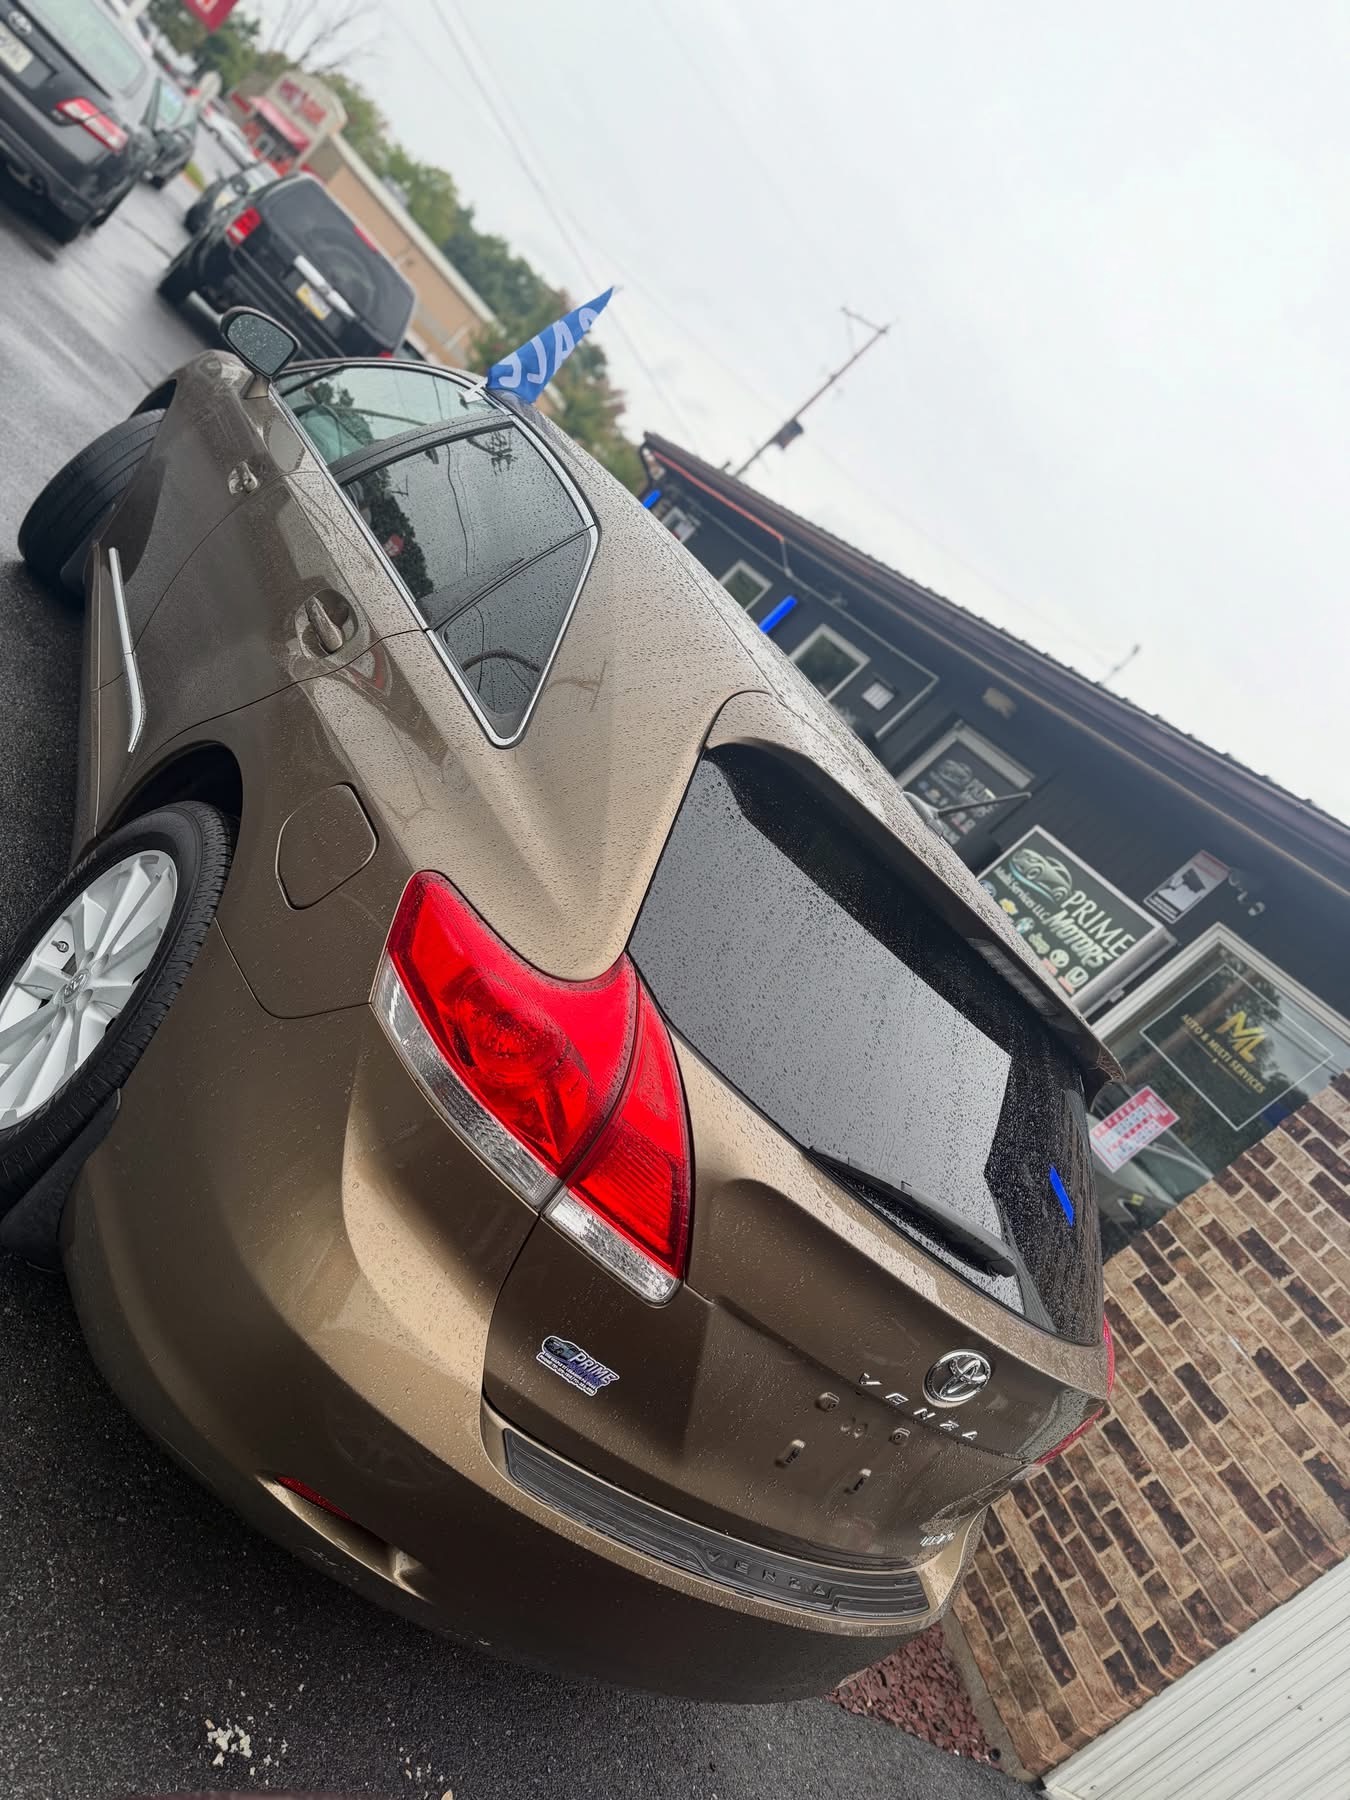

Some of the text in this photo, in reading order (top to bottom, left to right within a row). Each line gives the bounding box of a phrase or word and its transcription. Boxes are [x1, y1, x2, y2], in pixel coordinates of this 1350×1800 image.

[994, 867, 1050, 924] Multi Services LLC
[1061, 890, 1136, 958] PRIME
[1045, 909, 1113, 968] MOTORS
[1182, 1014, 1266, 1094] AUTO & MULTI SERVICES
[1216, 1011, 1265, 1063] ML
[569, 1352, 617, 1383] PRIME
[859, 1373, 978, 1440] VENZA
[706, 1550, 826, 1596] VENZA
